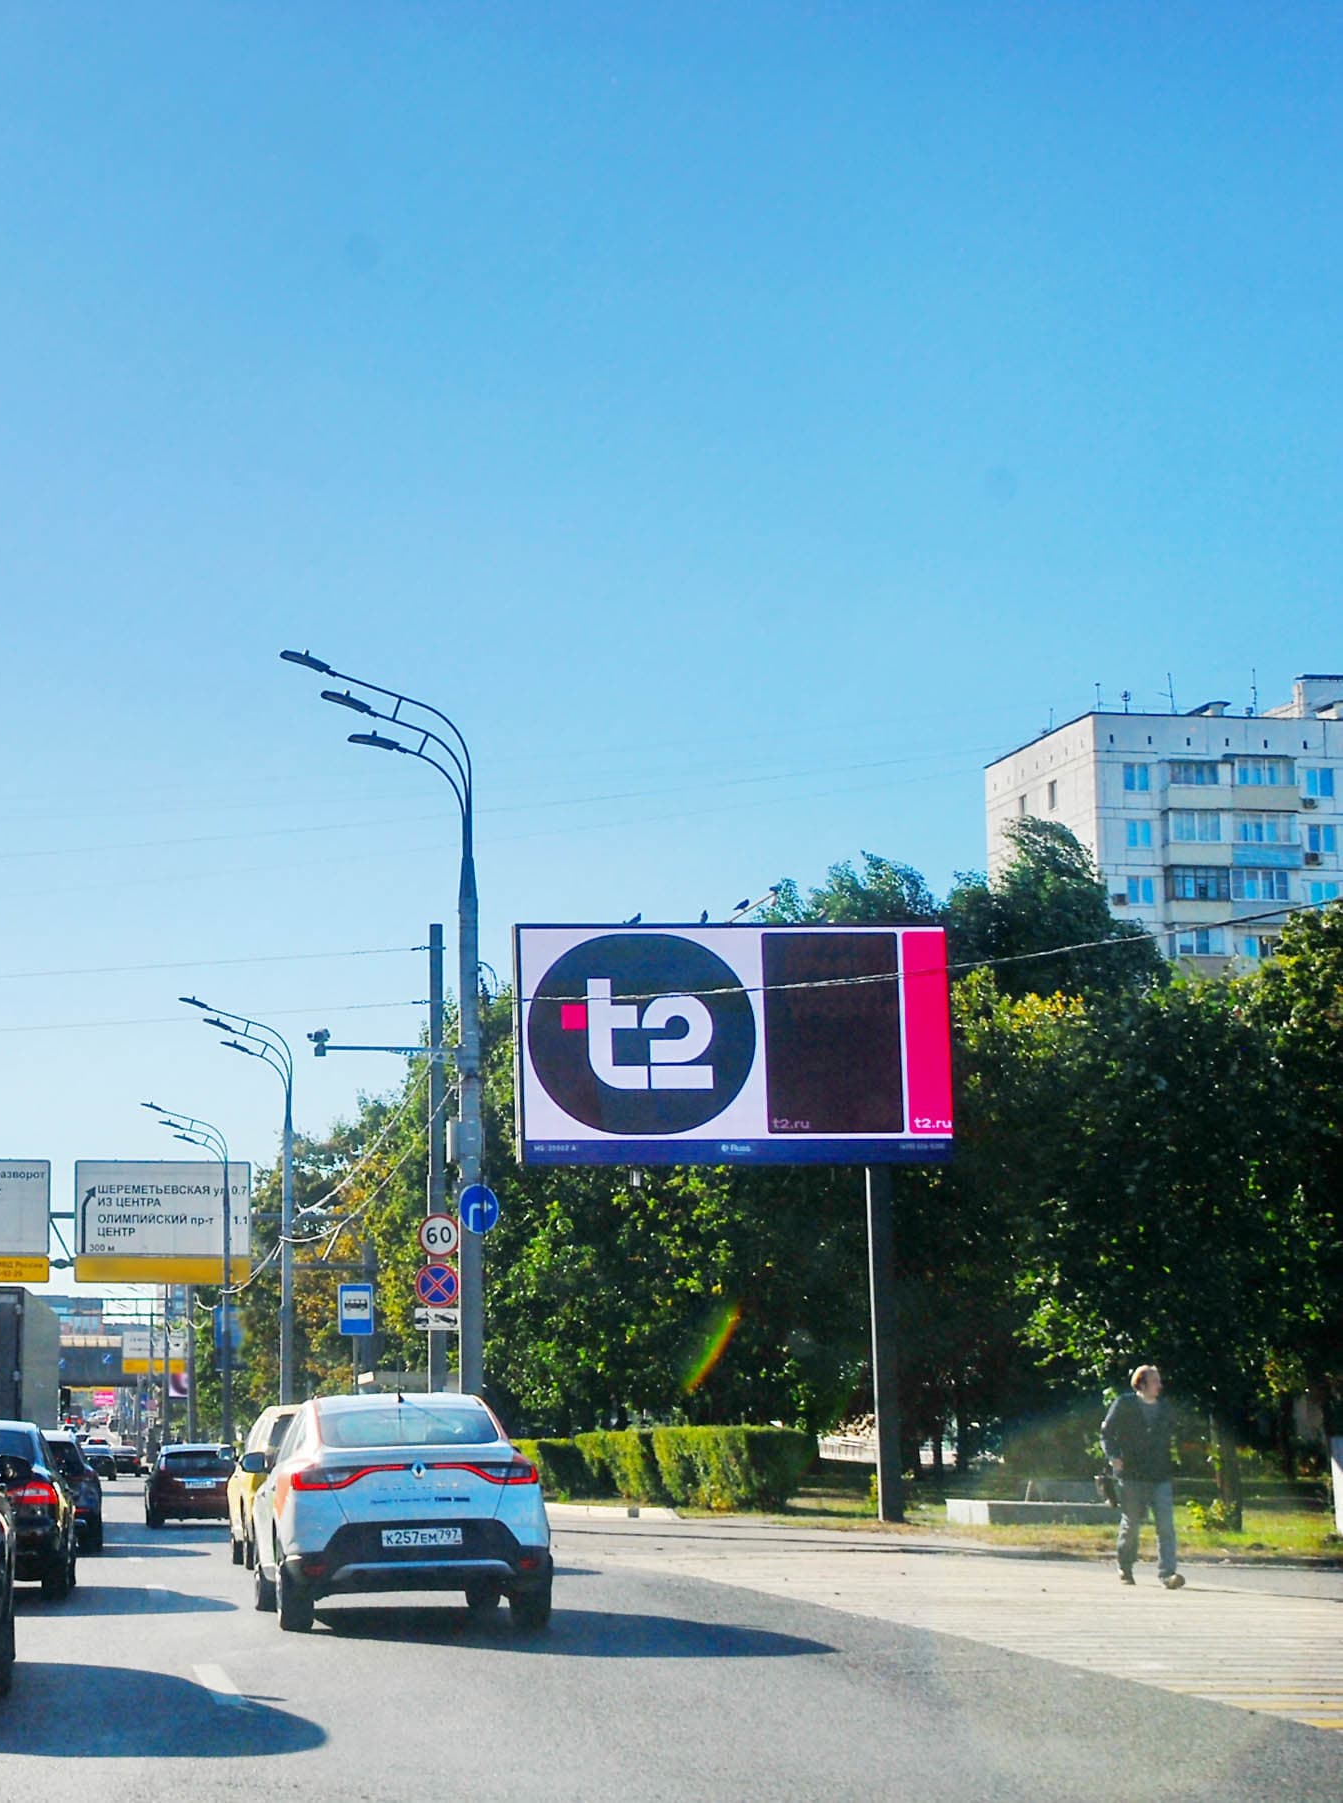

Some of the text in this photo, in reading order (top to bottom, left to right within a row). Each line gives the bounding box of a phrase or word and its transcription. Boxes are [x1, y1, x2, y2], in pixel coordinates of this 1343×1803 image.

[587, 978, 714, 1090] t2
[773, 1118, 809, 1129] t2.ru
[914, 1118, 952, 1129] t2.ru
[97, 1184, 210, 1195] ШЕРЕМЕТЬЕВСКАЯ
[97, 1198, 161, 1208] ИЗ ЦЕНТРА
[97, 1213, 248, 1227] ОЛИМПИЙСКИЙ пр-т 1.1
[97, 1227, 136, 1238] ЦЕНТР
[426, 1226, 452, 1245] 60
